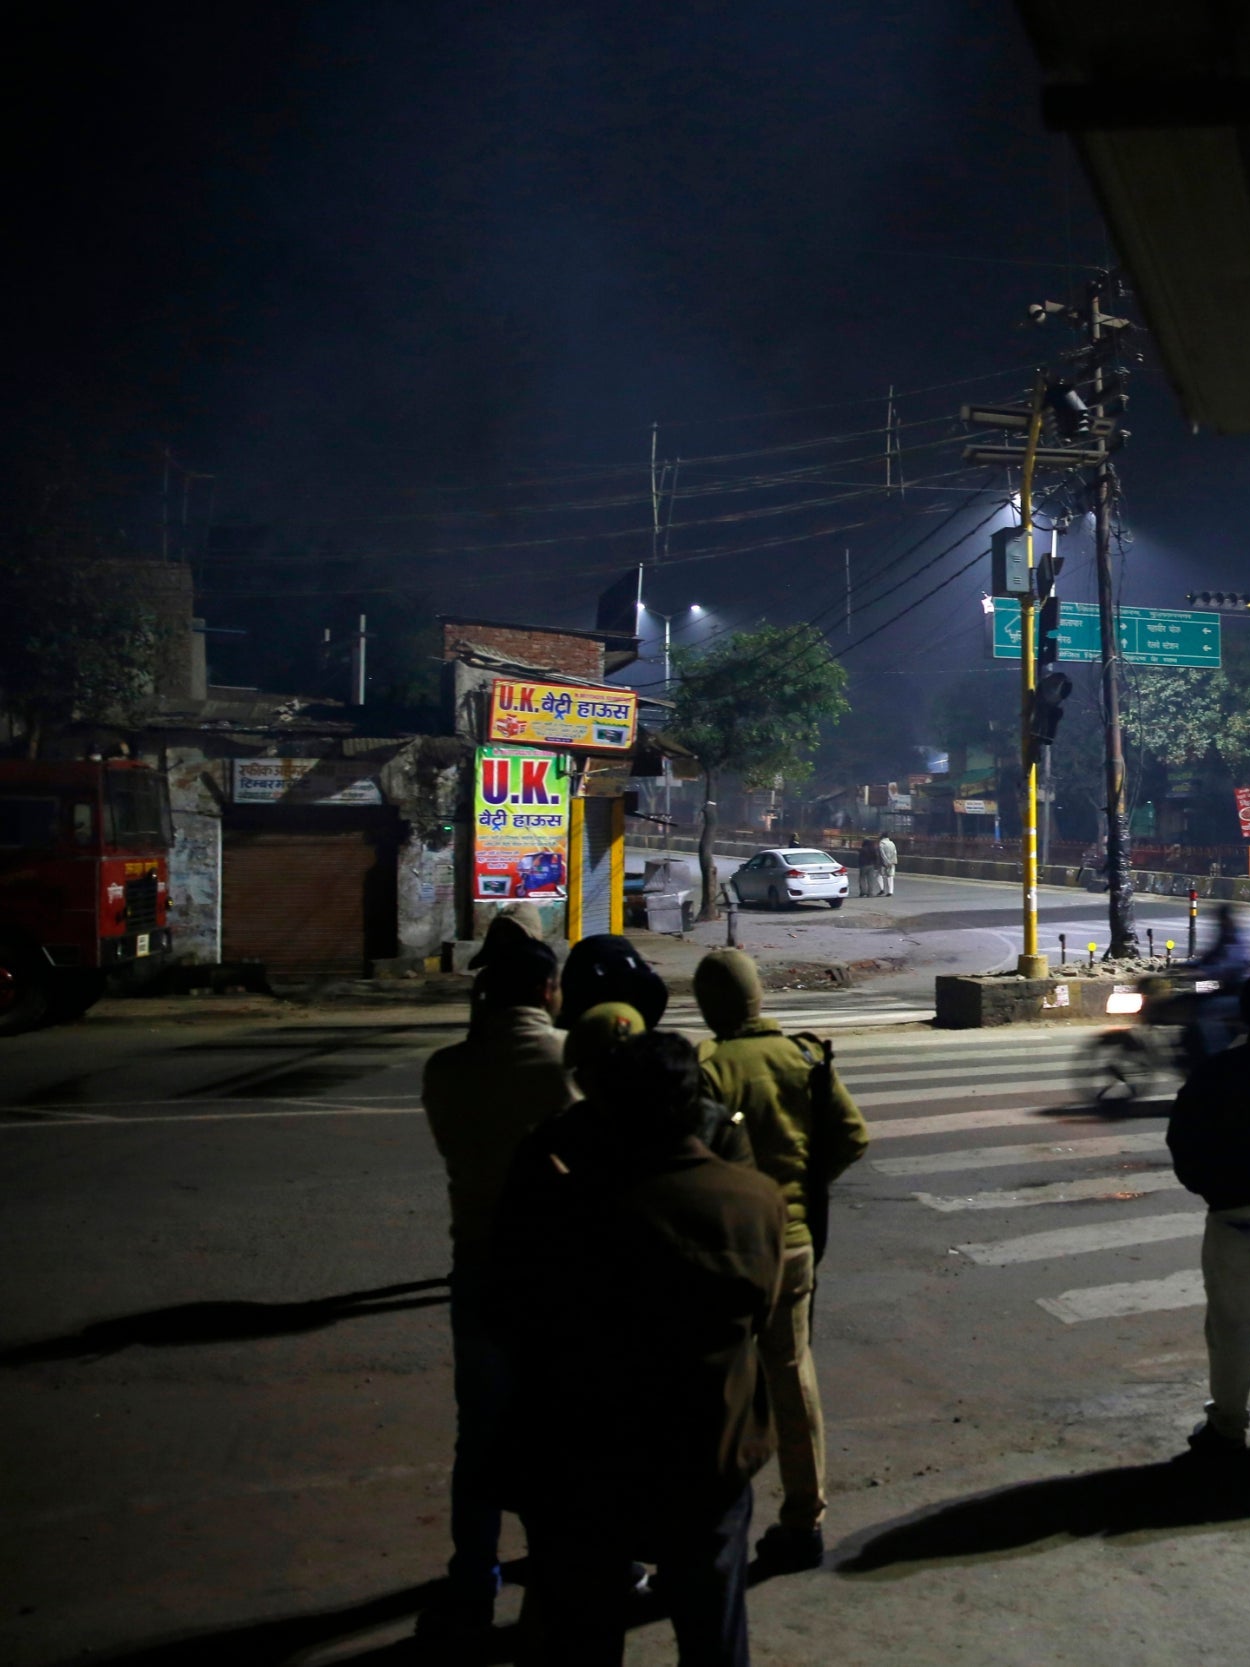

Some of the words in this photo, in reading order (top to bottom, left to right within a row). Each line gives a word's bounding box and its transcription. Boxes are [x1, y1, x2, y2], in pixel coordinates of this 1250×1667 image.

[499, 685, 539, 713] U.K.
[541, 692, 572, 720] बैट्री
[577, 701, 630, 719] हाऊस
[481, 759, 560, 805] U.K.
[479, 809, 508, 831] बैट्री
[512, 814, 563, 828] हाऊस
